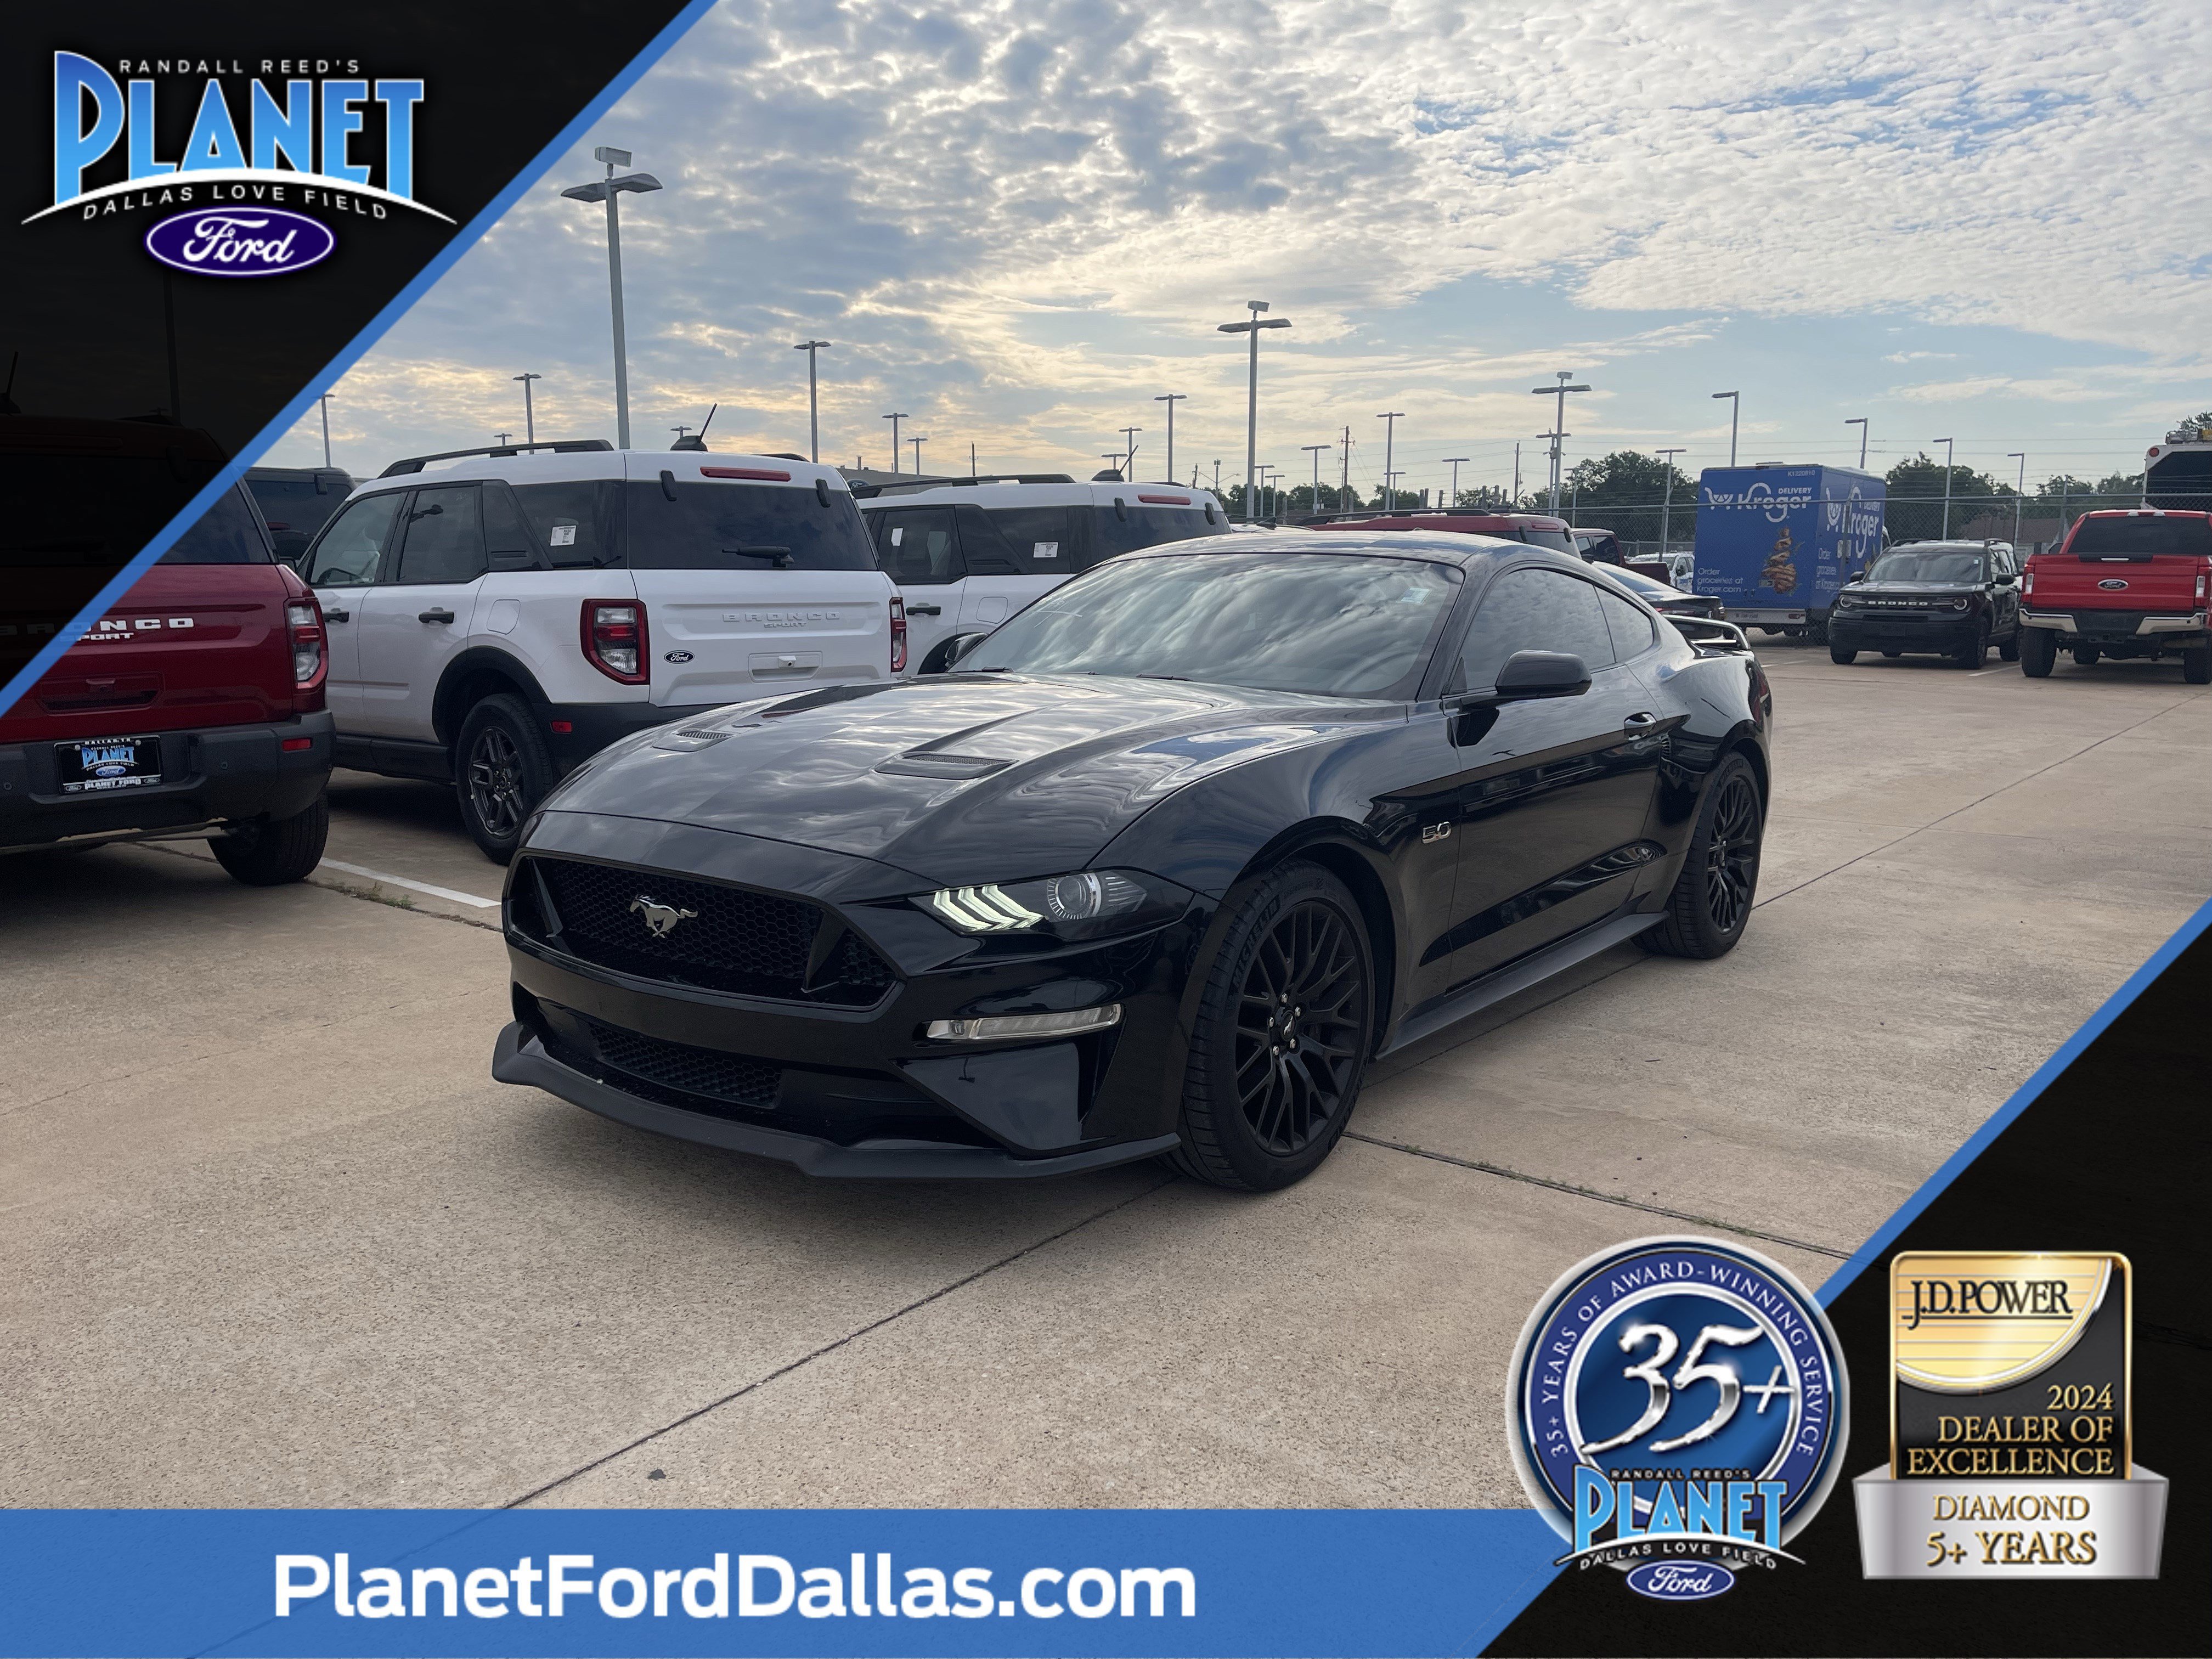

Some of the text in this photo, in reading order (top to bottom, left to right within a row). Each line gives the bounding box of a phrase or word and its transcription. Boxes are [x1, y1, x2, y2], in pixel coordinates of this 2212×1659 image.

[1737, 483, 1812, 523] Kroger
[722, 612, 840, 622] BRONCO
[670, 653, 689, 661] Ford
[82, 747, 134, 768] PLANET
[1421, 821, 1452, 844] 5.0
